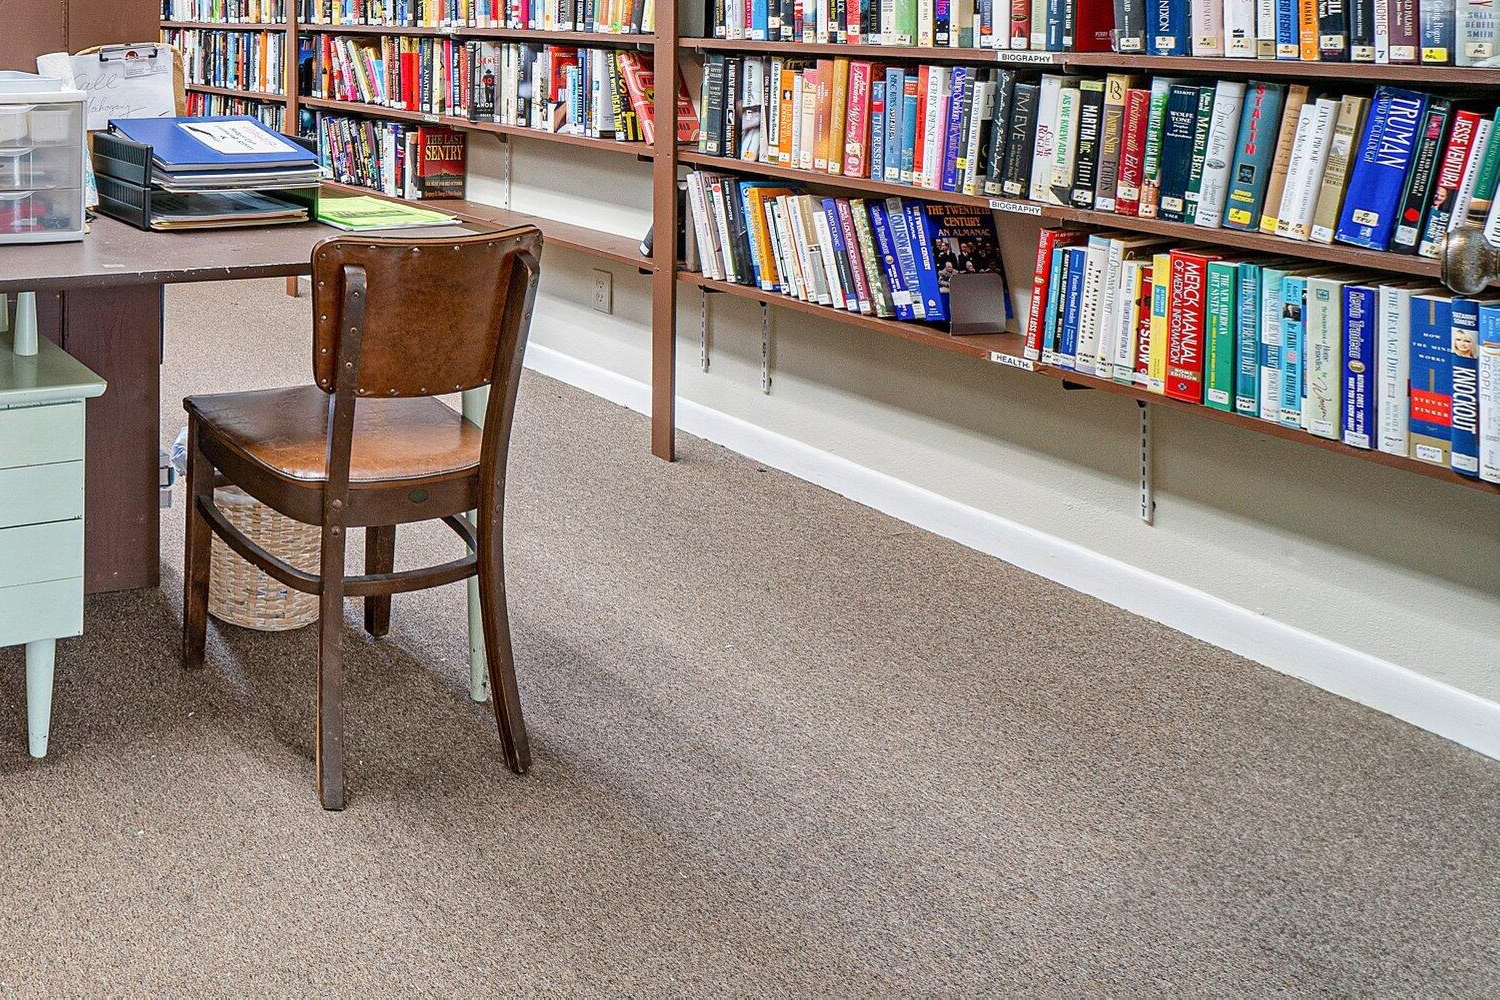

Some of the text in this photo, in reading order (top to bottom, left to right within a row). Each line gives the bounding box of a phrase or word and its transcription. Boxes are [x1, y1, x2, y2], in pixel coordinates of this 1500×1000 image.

[1159, 0, 1169, 32] NIXON
[1280, 12, 1291, 44] REGRETS
[1467, 30, 1493, 38] SMITH
[1001, 53, 1051, 62] BIOGRAPHY
[1063, 104, 1071, 115] WE
[1170, 110, 1194, 118] WOLFE
[1171, 116, 1192, 124] TONE
[1245, 83, 1266, 156] STALIN
[1012, 114, 1028, 141] EVE
[1080, 104, 1098, 144] MARTHA
[1195, 115, 1209, 151] MABEL
[1376, 97, 1421, 170] TRUMAN
[425, 146, 463, 161] SENTRY
[426, 135, 464, 145] THE LAST
[872, 115, 882, 178] TIM RUSSERT
[1035, 124, 1048, 157] ROGER
[1439, 116, 1473, 189] JESSE VENTURA
[927, 205, 990, 215] THE TWENTIETH
[991, 201, 1040, 214] BIOGRAPHY
[944, 217, 980, 227] CENTURY
[953, 228, 990, 236] ALMANAC
[1170, 260, 1184, 364] OF MEDICAL INFORMATION
[1180, 262, 1200, 365] MERCK MANUAL
[1140, 330, 1150, 366] SLOW
[1413, 396, 1449, 408] STEVEN
[1415, 407, 1449, 418] PINKER
[1453, 365, 1477, 434] KNOCKOUT
